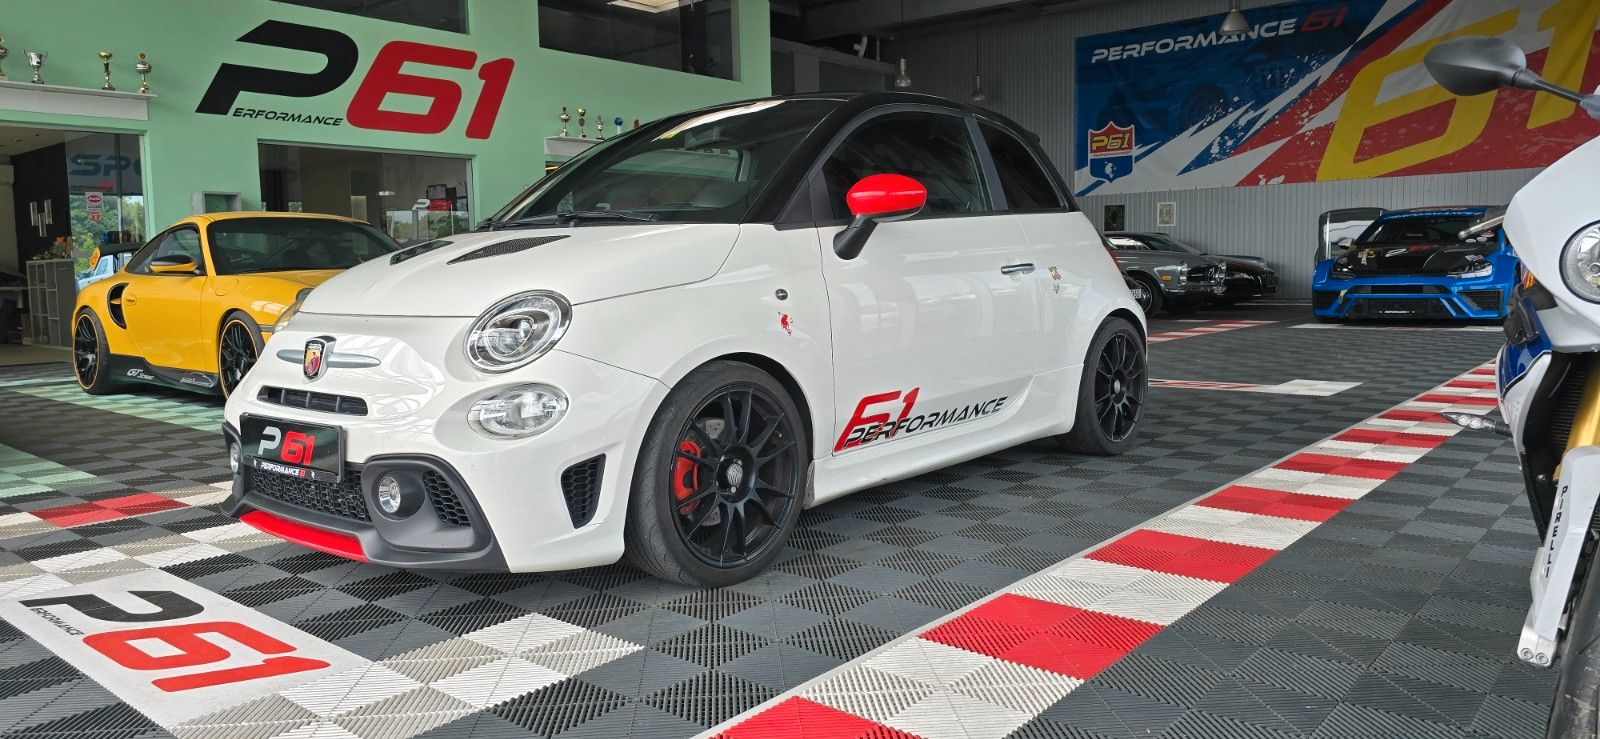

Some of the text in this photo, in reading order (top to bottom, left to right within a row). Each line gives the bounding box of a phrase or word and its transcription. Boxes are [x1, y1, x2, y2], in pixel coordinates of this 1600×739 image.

[1091, 7, 1348, 64] PERFORMANCE 61
[1091, 133, 1131, 151] P61
[257, 425, 316, 466] P61
[844, 395, 1009, 449] PERFORMANCE
[1545, 485, 1569, 578] PIRELLI
